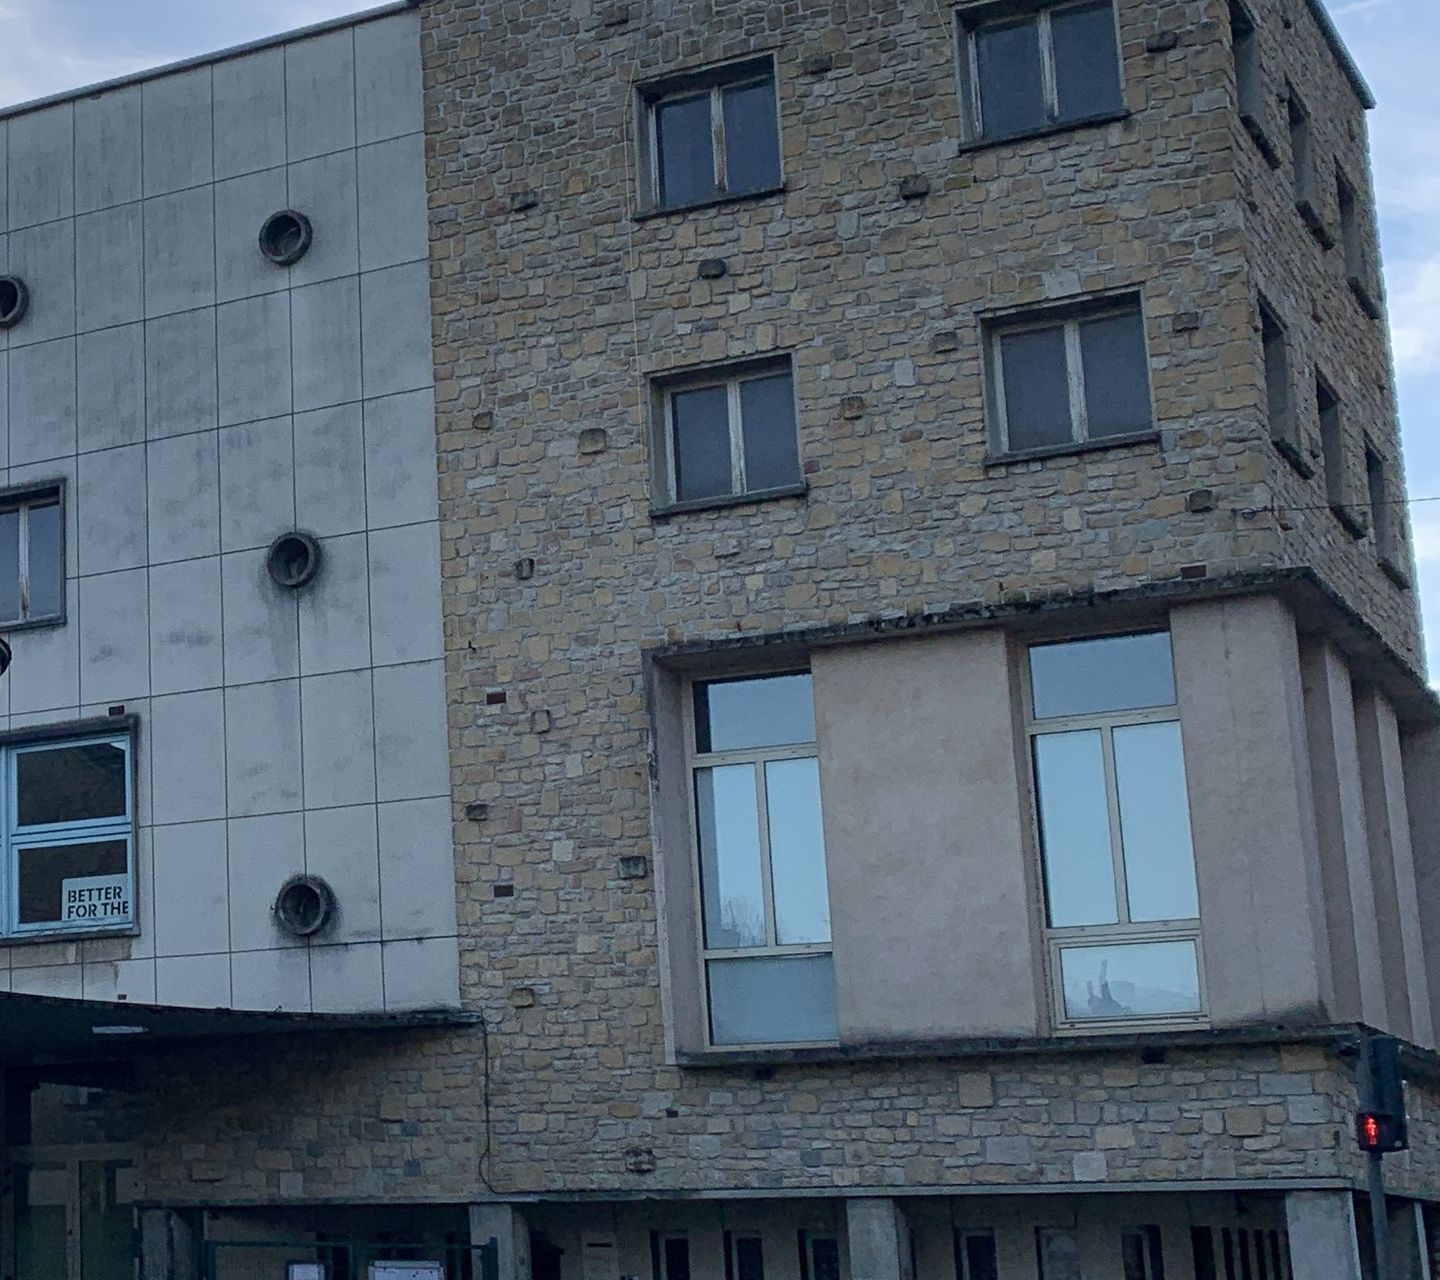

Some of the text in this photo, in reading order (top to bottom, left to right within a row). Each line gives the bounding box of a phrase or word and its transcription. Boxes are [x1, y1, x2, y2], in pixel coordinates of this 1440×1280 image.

[68, 886, 122, 903] BETTER
[68, 901, 128, 919] FOR THE
